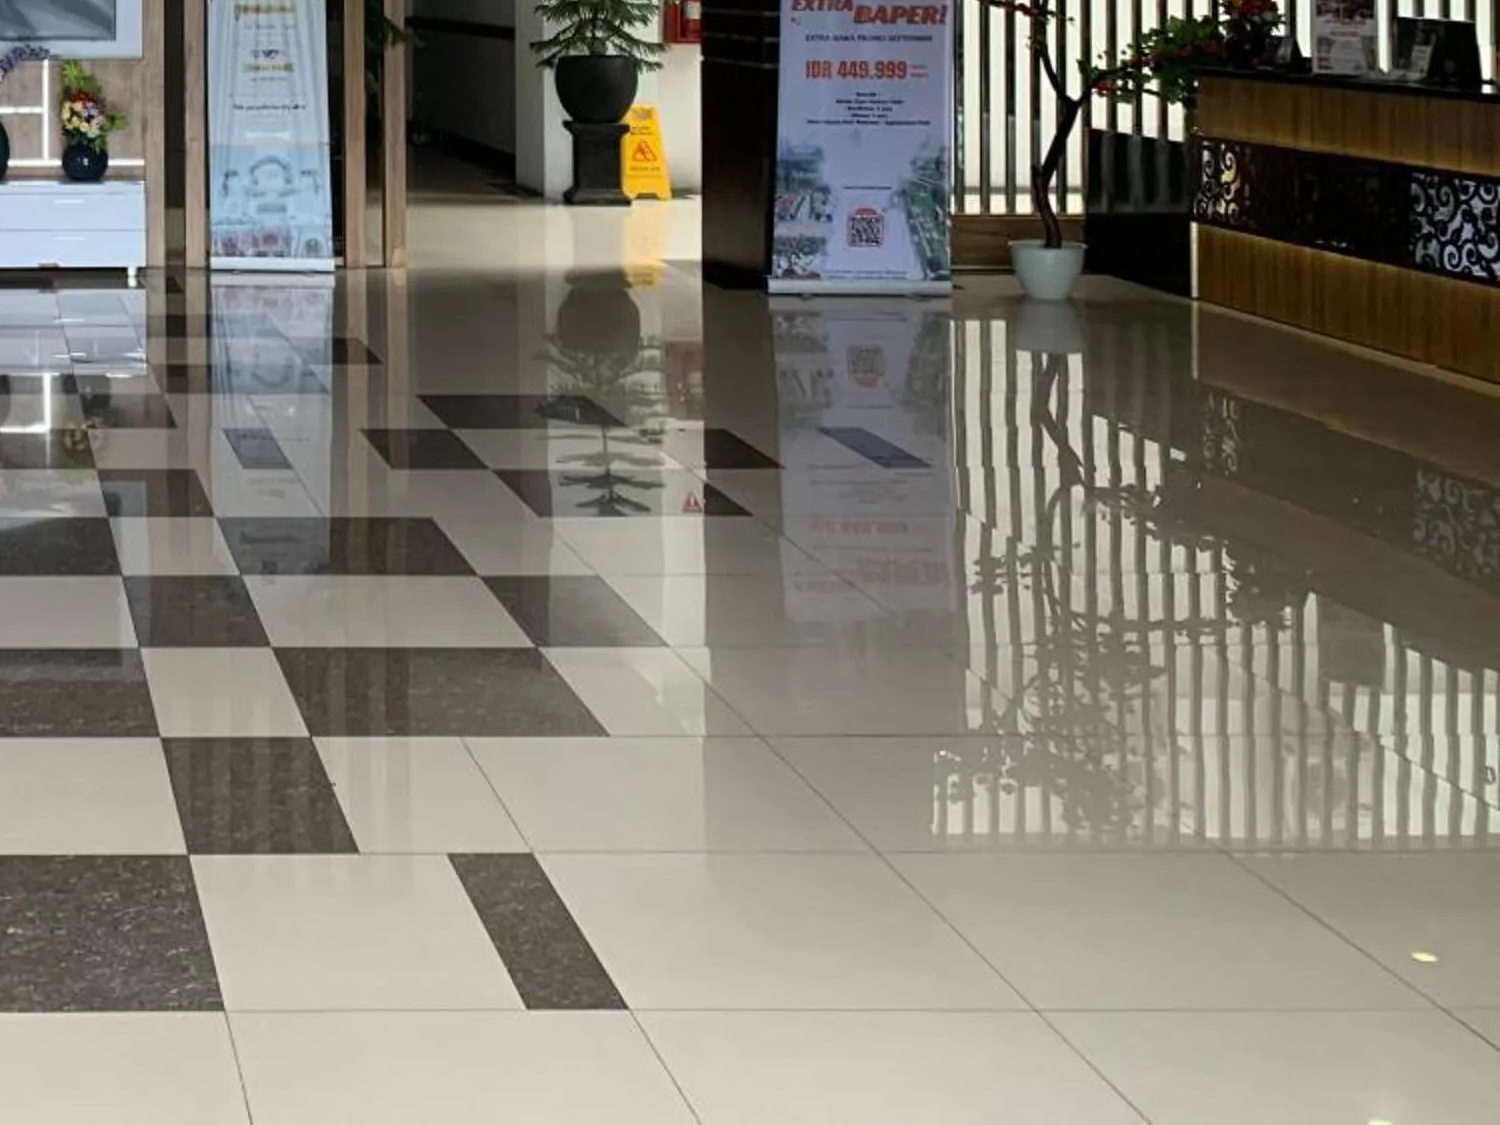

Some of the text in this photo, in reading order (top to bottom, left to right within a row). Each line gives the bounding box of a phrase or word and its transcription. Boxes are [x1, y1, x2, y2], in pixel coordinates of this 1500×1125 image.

[853, 4, 948, 25] BAPER!
[805, 60, 907, 80] IDR 449.999
